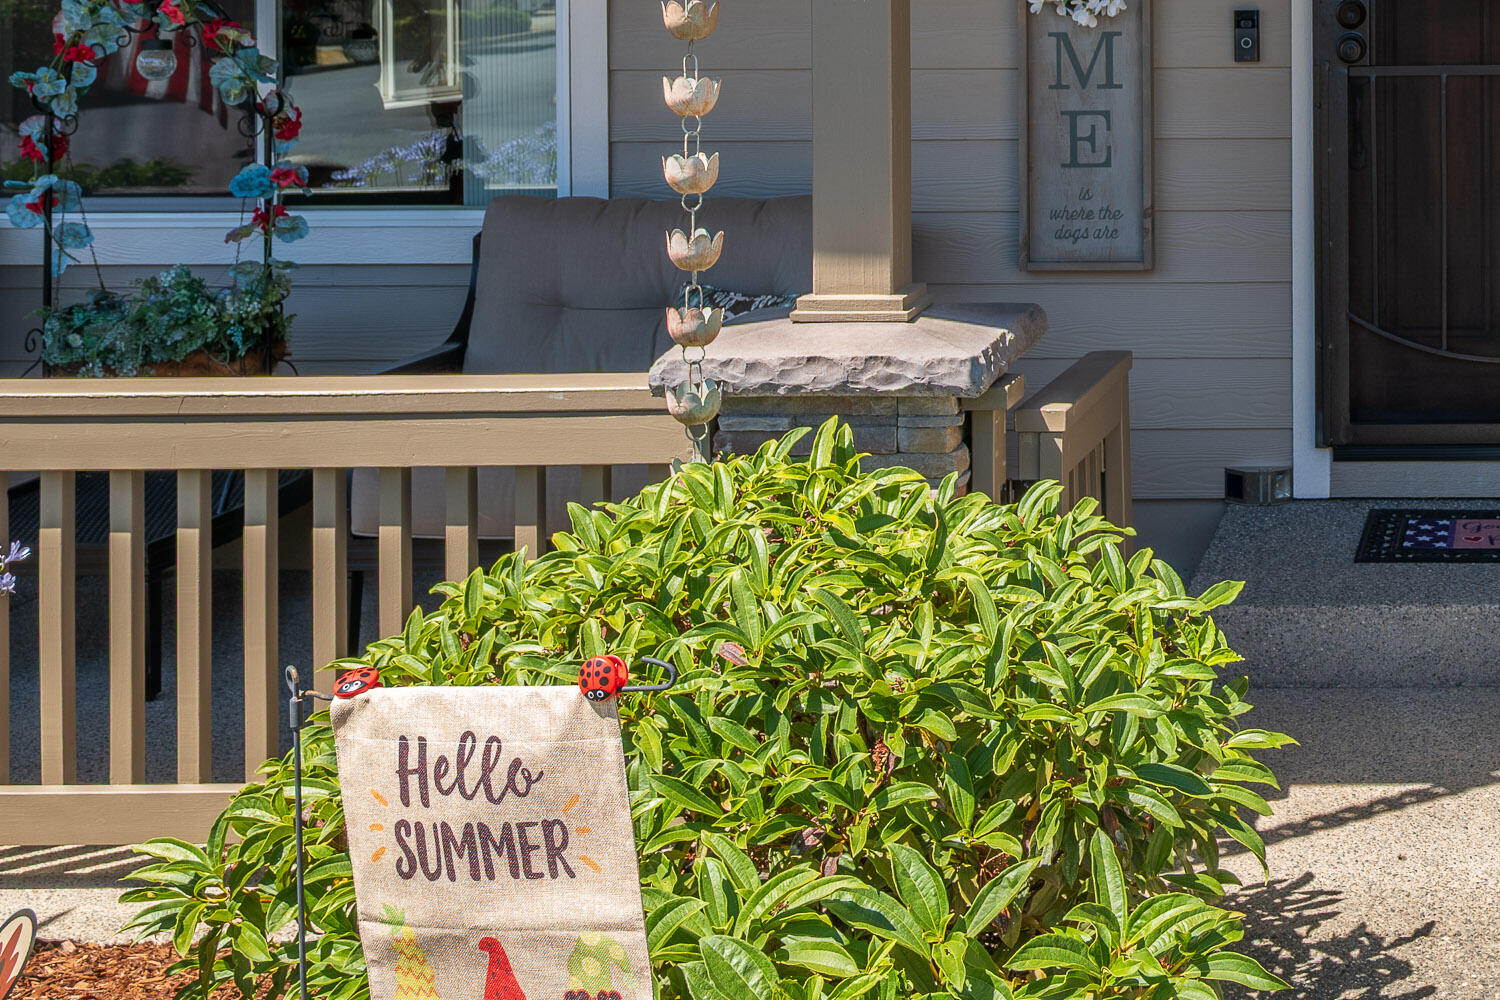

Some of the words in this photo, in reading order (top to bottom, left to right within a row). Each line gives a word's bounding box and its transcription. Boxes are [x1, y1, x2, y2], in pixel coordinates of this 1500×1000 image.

[1078, 186, 1095, 201] is
[1049, 204, 1096, 221] where
[1098, 204, 1124, 221] the
[1054, 224, 1089, 245] dogs
[1092, 225, 1120, 240] are
[395, 730, 544, 808] Hello
[394, 818, 577, 882] SUMMER
